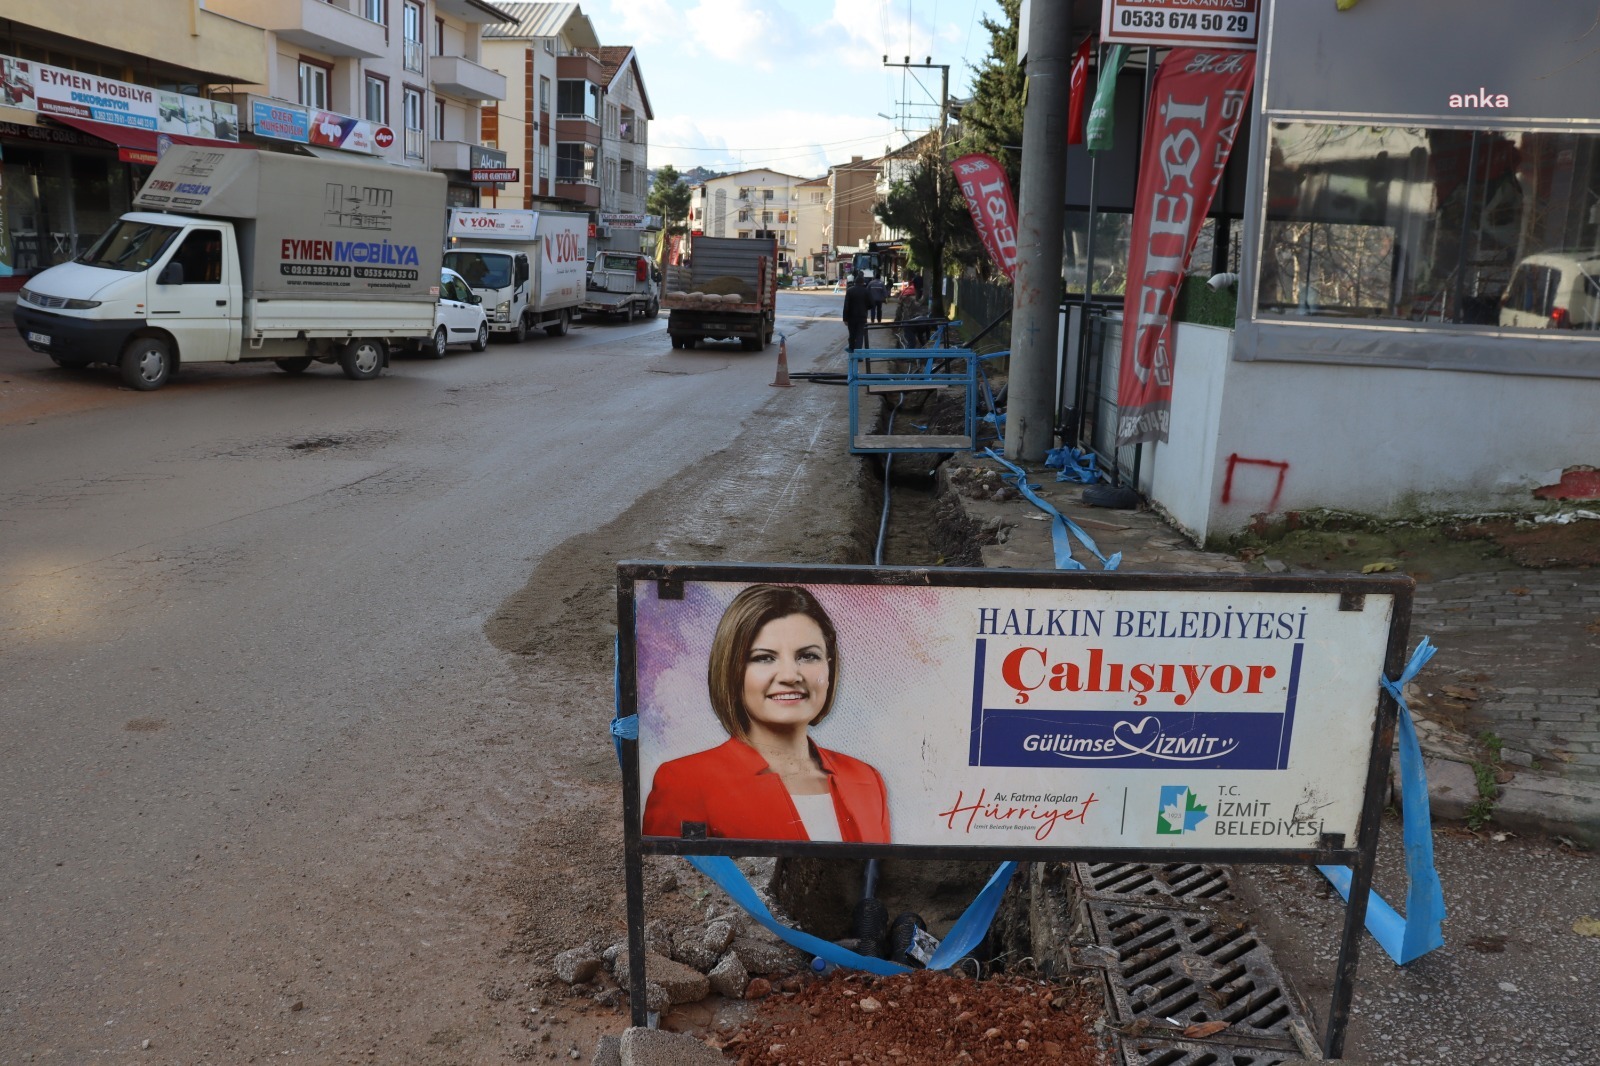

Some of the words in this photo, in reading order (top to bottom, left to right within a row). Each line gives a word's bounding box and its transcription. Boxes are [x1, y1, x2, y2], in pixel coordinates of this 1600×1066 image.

[1121, 10, 1164, 28] 0533
[1169, 12, 1197, 29] 674
[1201, 13, 1223, 31] 50
[1226, 15, 1248, 32] 29
[40, 68, 91, 91] EYMEN
[97, 81, 153, 103] MOBİLYA
[71, 91, 129, 110] DEKORASYON
[320, 116, 342, 142] dyo
[376, 133, 392, 142] dyo
[149, 180, 176, 191] EYMEN
[174, 182, 212, 196] MOBİLYA
[470, 217, 497, 228] YÖN
[281, 239, 332, 260] EYMEN
[334, 239, 419, 266] MOBİLYA
[556, 229, 579, 263] YÖN
[291, 265, 312, 275] 0262
[313, 266, 328, 275] 323
[329, 266, 339, 276] 79
[340, 267, 349, 276] 61
[364, 268, 382, 277] 0535
[383, 268, 396, 278] 440
[397, 269, 407, 278] 33
[407, 270, 417, 279] 61
[976, 608, 1105, 637] HALKIN
[1113, 605, 1308, 640] BELEDİYESİ
[1001, 646, 1277, 706] Çalışıyor
[1023, 734, 1116, 752] Gülümse
[1155, 733, 1219, 754] İZMİT
[994, 792, 1007, 802] Av.
[1010, 792, 1041, 802] Fatma
[1043, 793, 1078, 805] Kaplan
[1217, 785, 1241, 796] T.C.
[939, 788, 1099, 841] Hürriyet
[1216, 799, 1271, 817] İZMİT
[1214, 818, 1325, 836] BELEDİYESİ
